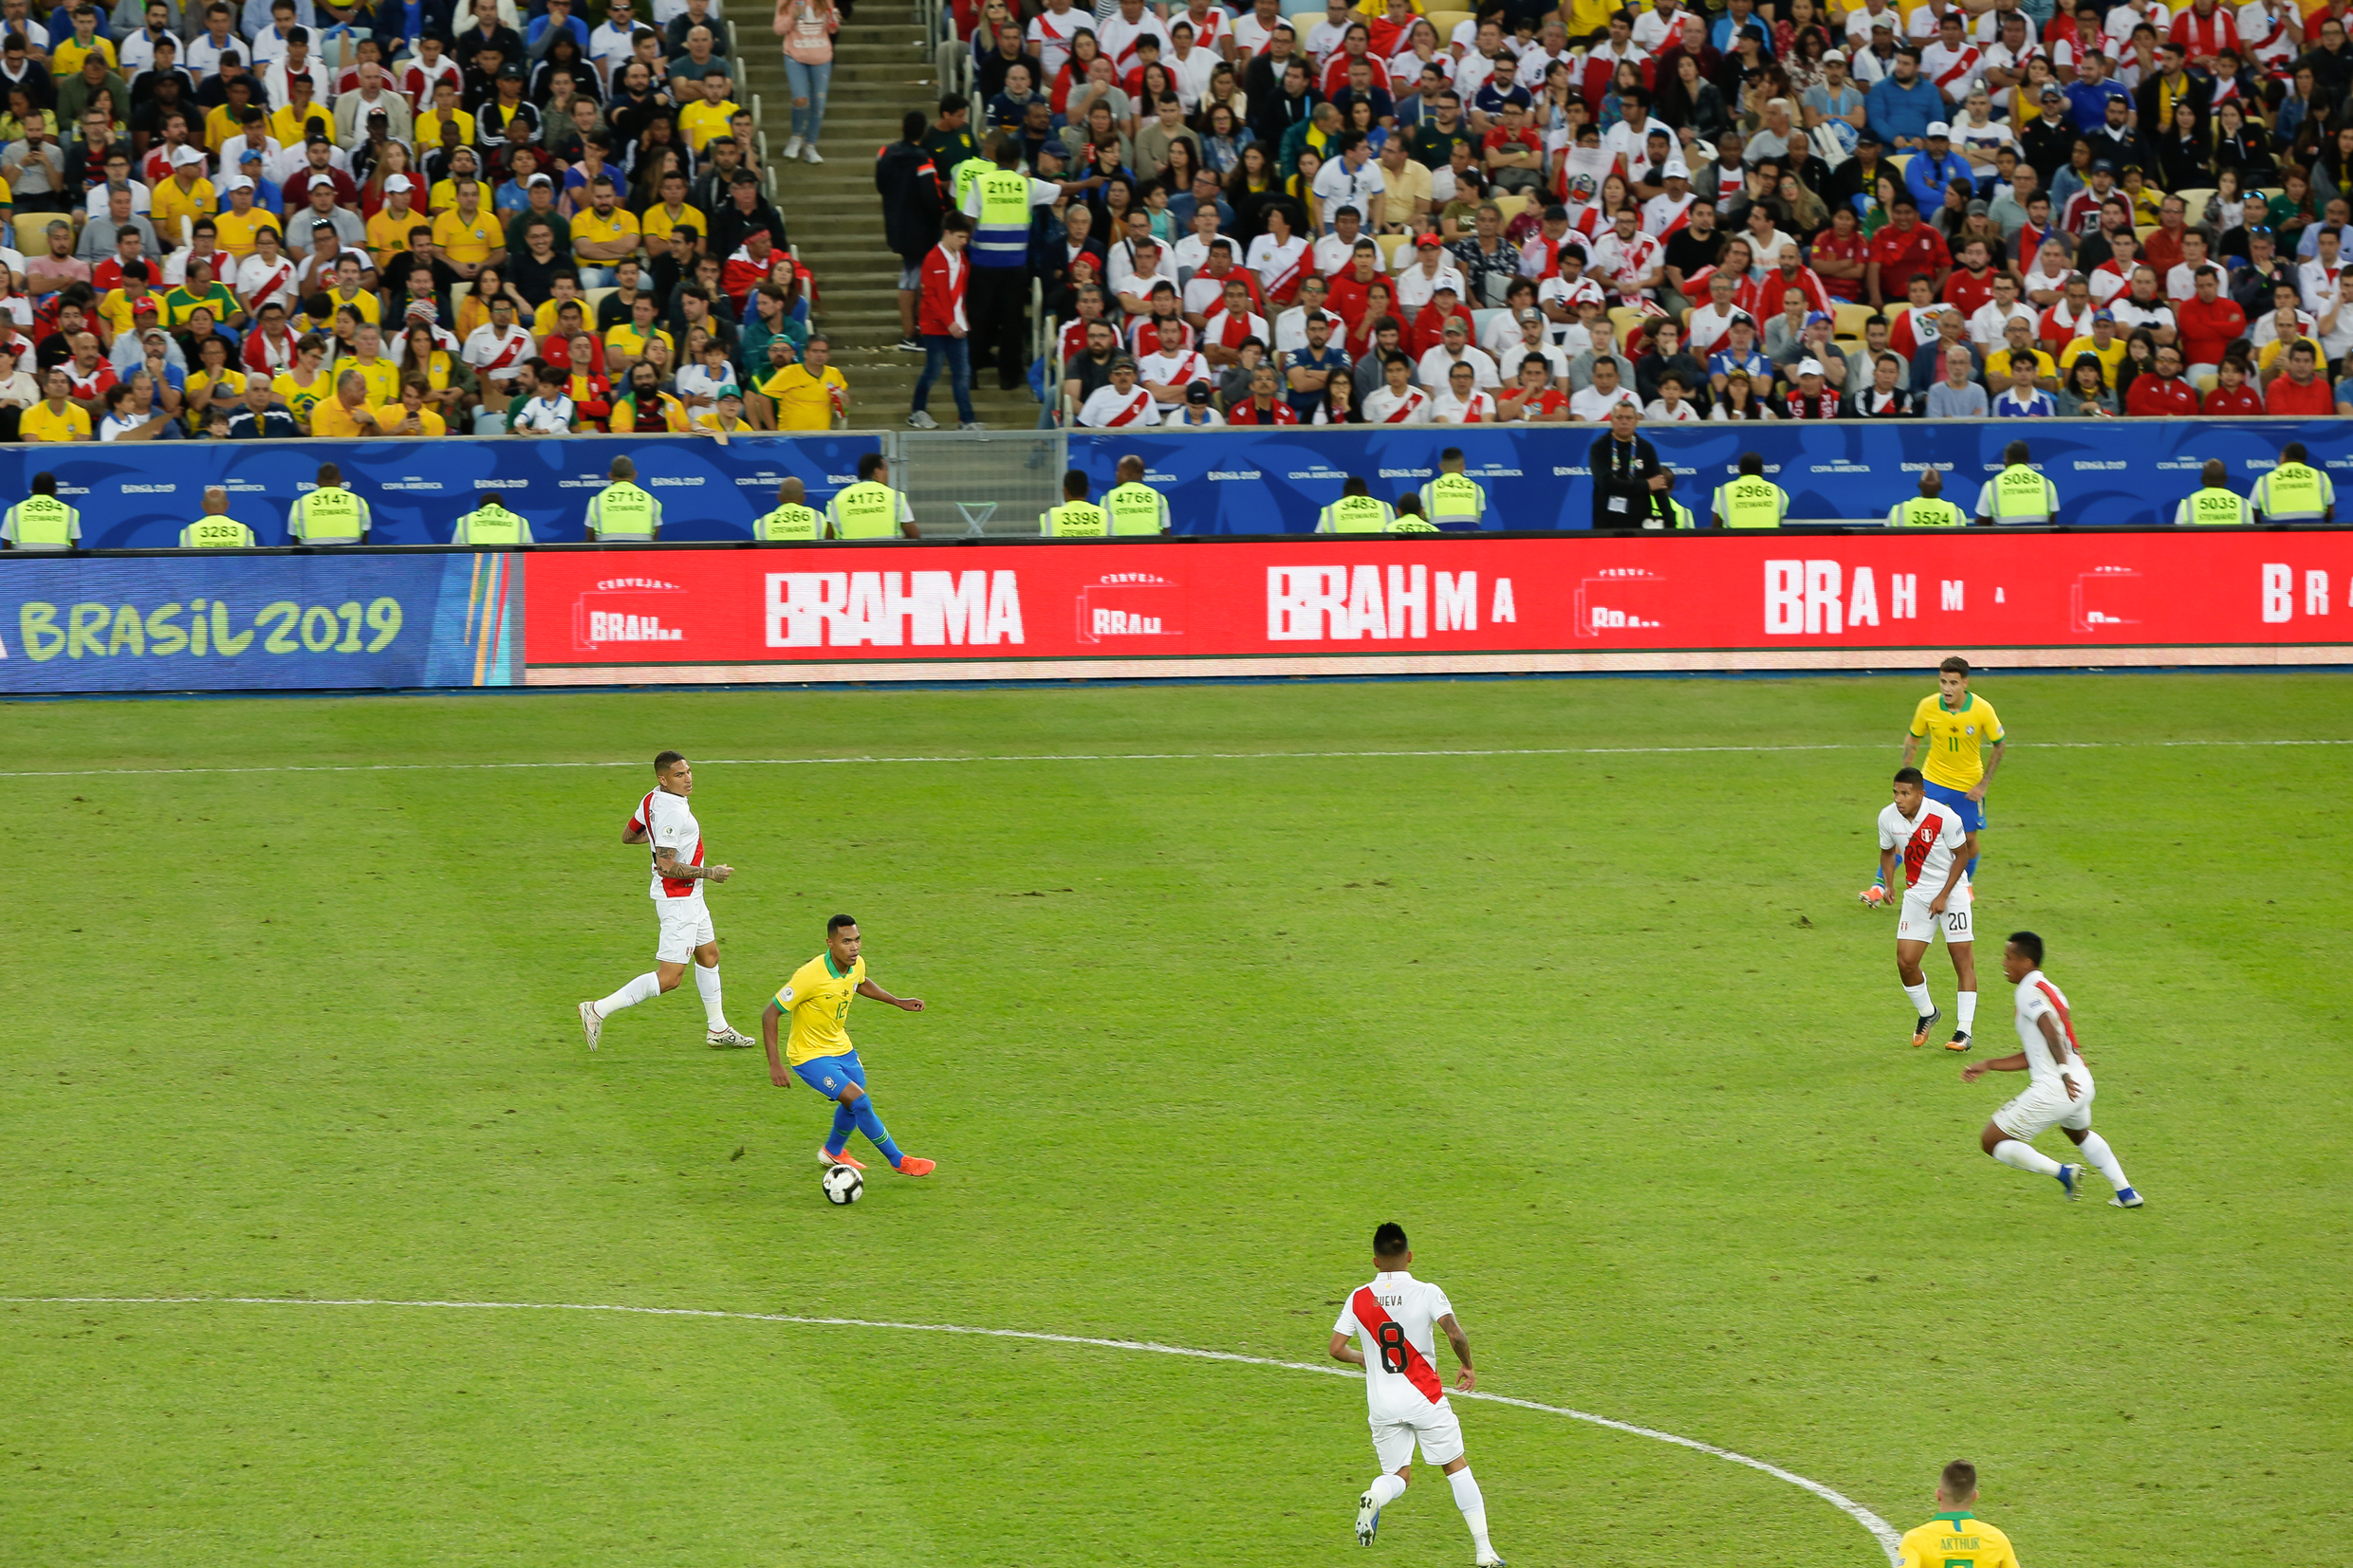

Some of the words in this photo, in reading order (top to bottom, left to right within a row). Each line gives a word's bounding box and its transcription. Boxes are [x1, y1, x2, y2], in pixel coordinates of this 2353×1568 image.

[987, 181, 1024, 194] 2114
[606, 491, 645, 503] 5713
[846, 491, 886, 505] 4173
[1115, 491, 1154, 505] 4766
[1735, 485, 1772, 498] 2966
[25, 500, 64, 513] 5694
[312, 493, 349, 507] 3147
[2199, 497, 2237, 510] 5035
[772, 510, 810, 524] 2366
[1061, 511, 1101, 526] 3398
[1911, 510, 1950, 526] 3524
[199, 526, 238, 538] 3283
[2262, 563, 2353, 623] BR
[765, 569, 1026, 647] BRAHMA
[1267, 564, 1516, 640] BRAHMA
[253, 597, 404, 655] 2019
[1948, 736, 1959, 752] 11
[1905, 844, 1927, 861] 20
[1948, 912, 1968, 931] 20
[836, 1001, 849, 1021] 12
[1372, 1295, 1402, 1308] CUEVA
[1378, 1321, 1409, 1374] 8
[1940, 1537, 1980, 1551] ARTHUR
